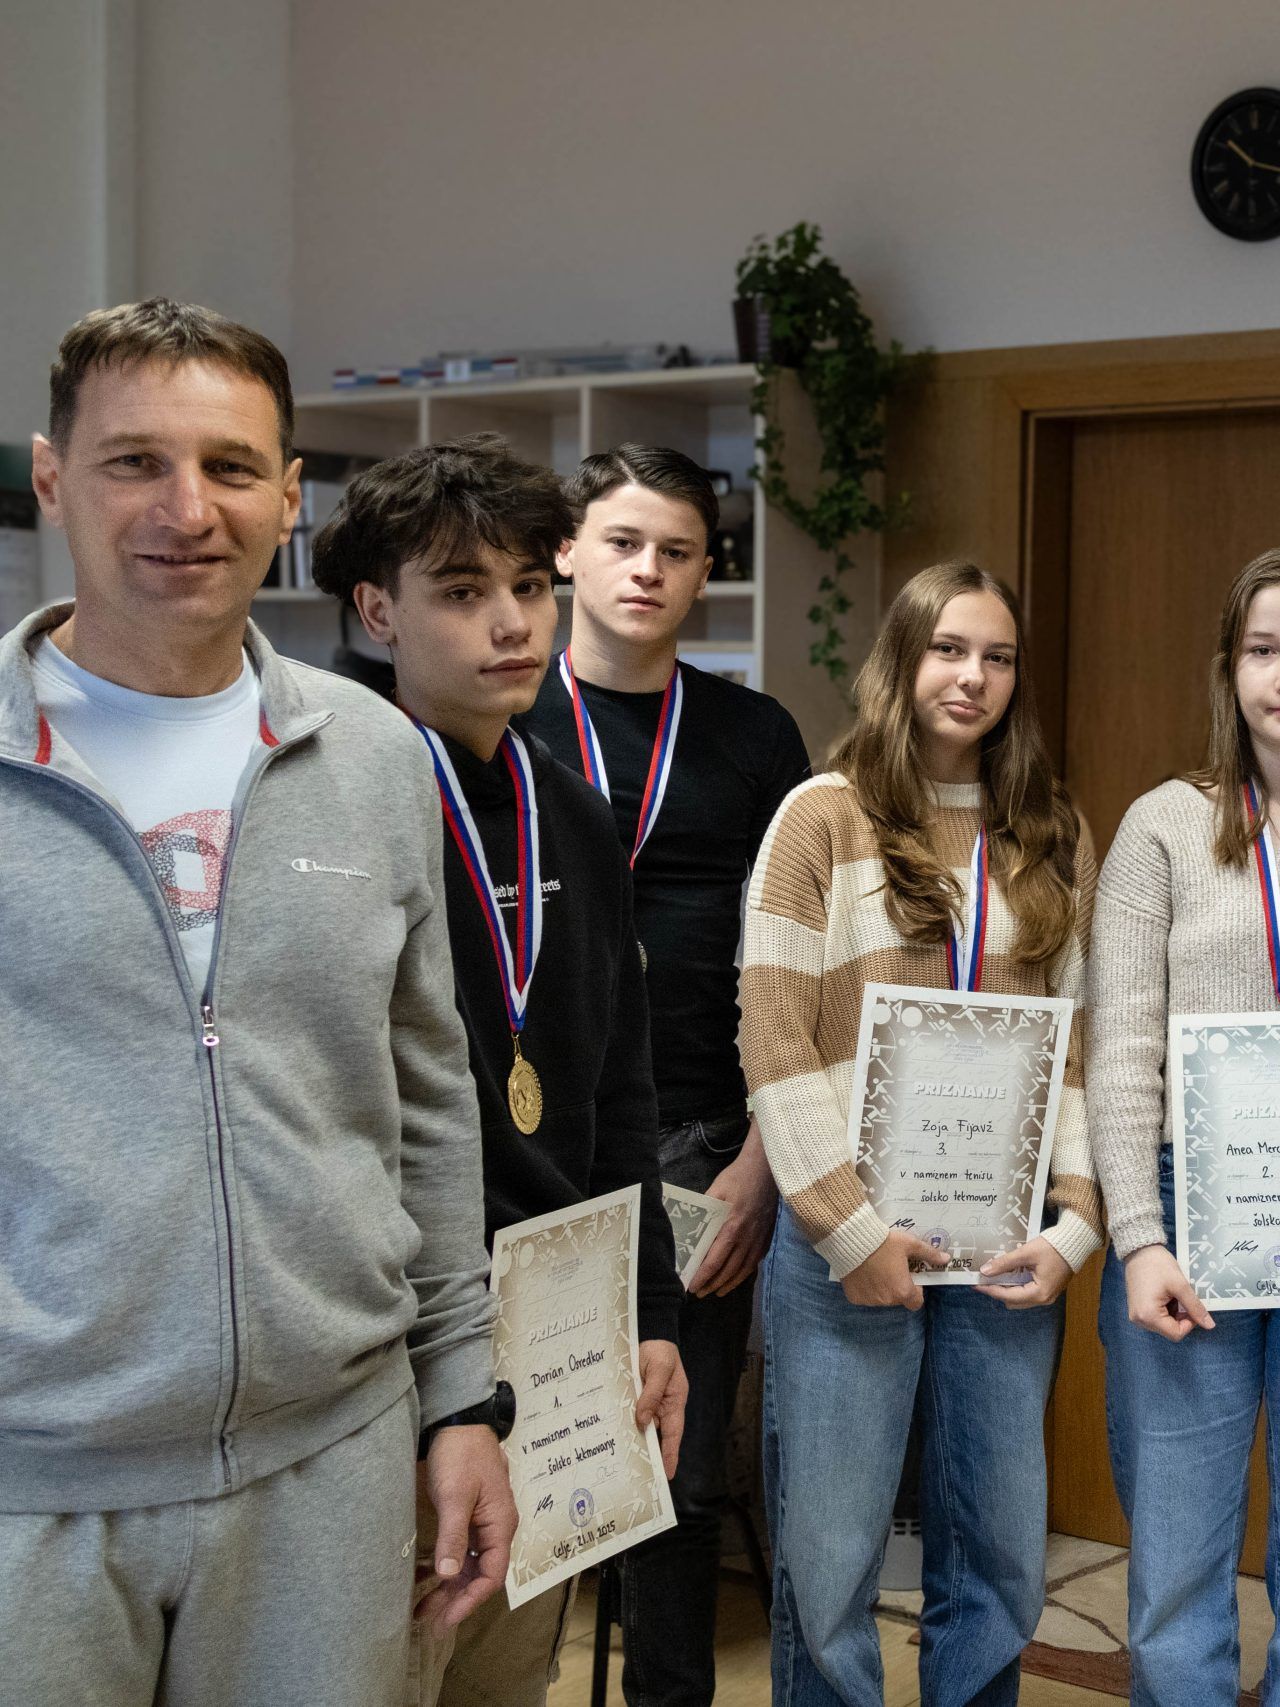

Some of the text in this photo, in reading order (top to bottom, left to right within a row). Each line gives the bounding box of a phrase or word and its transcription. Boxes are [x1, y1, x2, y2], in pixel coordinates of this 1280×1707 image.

[291, 858, 372, 880] Champion
[914, 1081, 1007, 1100] PRIZNANJE
[921, 1119, 994, 1140] Zoja Fijavž
[936, 1142, 947, 1156] 3.
[900, 1168, 993, 1180] v namiznem tenisu
[1262, 1166, 1274, 1179] 2.
[920, 1188, 997, 1207] šolsko tekmovanje
[1226, 1195, 1232, 1204] v
[1252, 1213, 1280, 1228] šolsko
[1256, 1279, 1280, 1295] Celje,
[527, 1305, 599, 1347] PRIZNANJE
[530, 1349, 605, 1388] Dorian Osredkar
[522, 1413, 601, 1455] v namiznem tenisu
[547, 1457, 572, 1476] šolsko
[575, 1433, 616, 1463] tekmovanje
